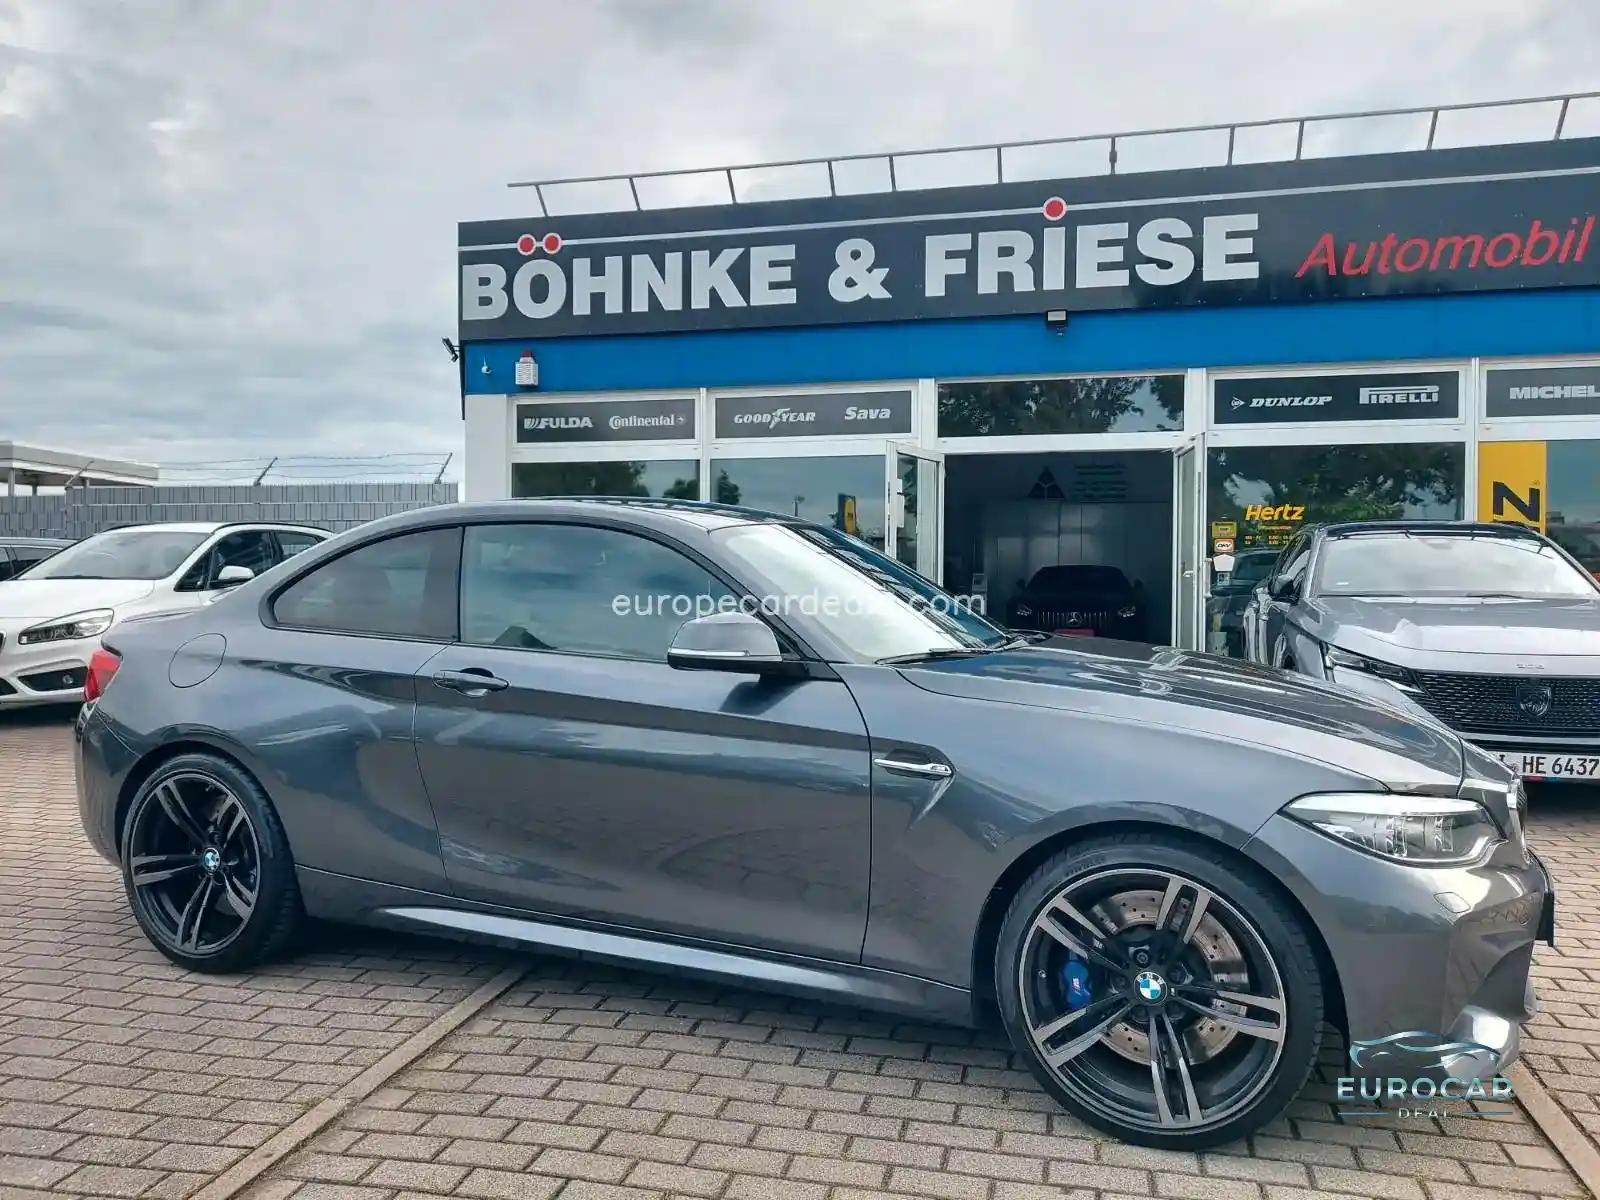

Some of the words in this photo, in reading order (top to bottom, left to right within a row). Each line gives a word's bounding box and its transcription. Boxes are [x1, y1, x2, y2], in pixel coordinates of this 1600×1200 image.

[462, 233, 797, 321] BÖHNKE
[828, 238, 892, 302] &
[925, 197, 1260, 297] FRIESE
[1295, 215, 1596, 278] Automobil
[1249, 396, 1333, 408] DUNLOP
[1359, 385, 1440, 405] PIRELLI
[734, 408, 816, 429] GOODYEAR
[844, 406, 891, 421] Sava
[539, 416, 594, 429] FULDA
[609, 414, 675, 430] Continental
[1245, 504, 1305, 520] Hertz
[1522, 755, 1547, 775] HE
[1551, 757, 1600, 776] 6437
